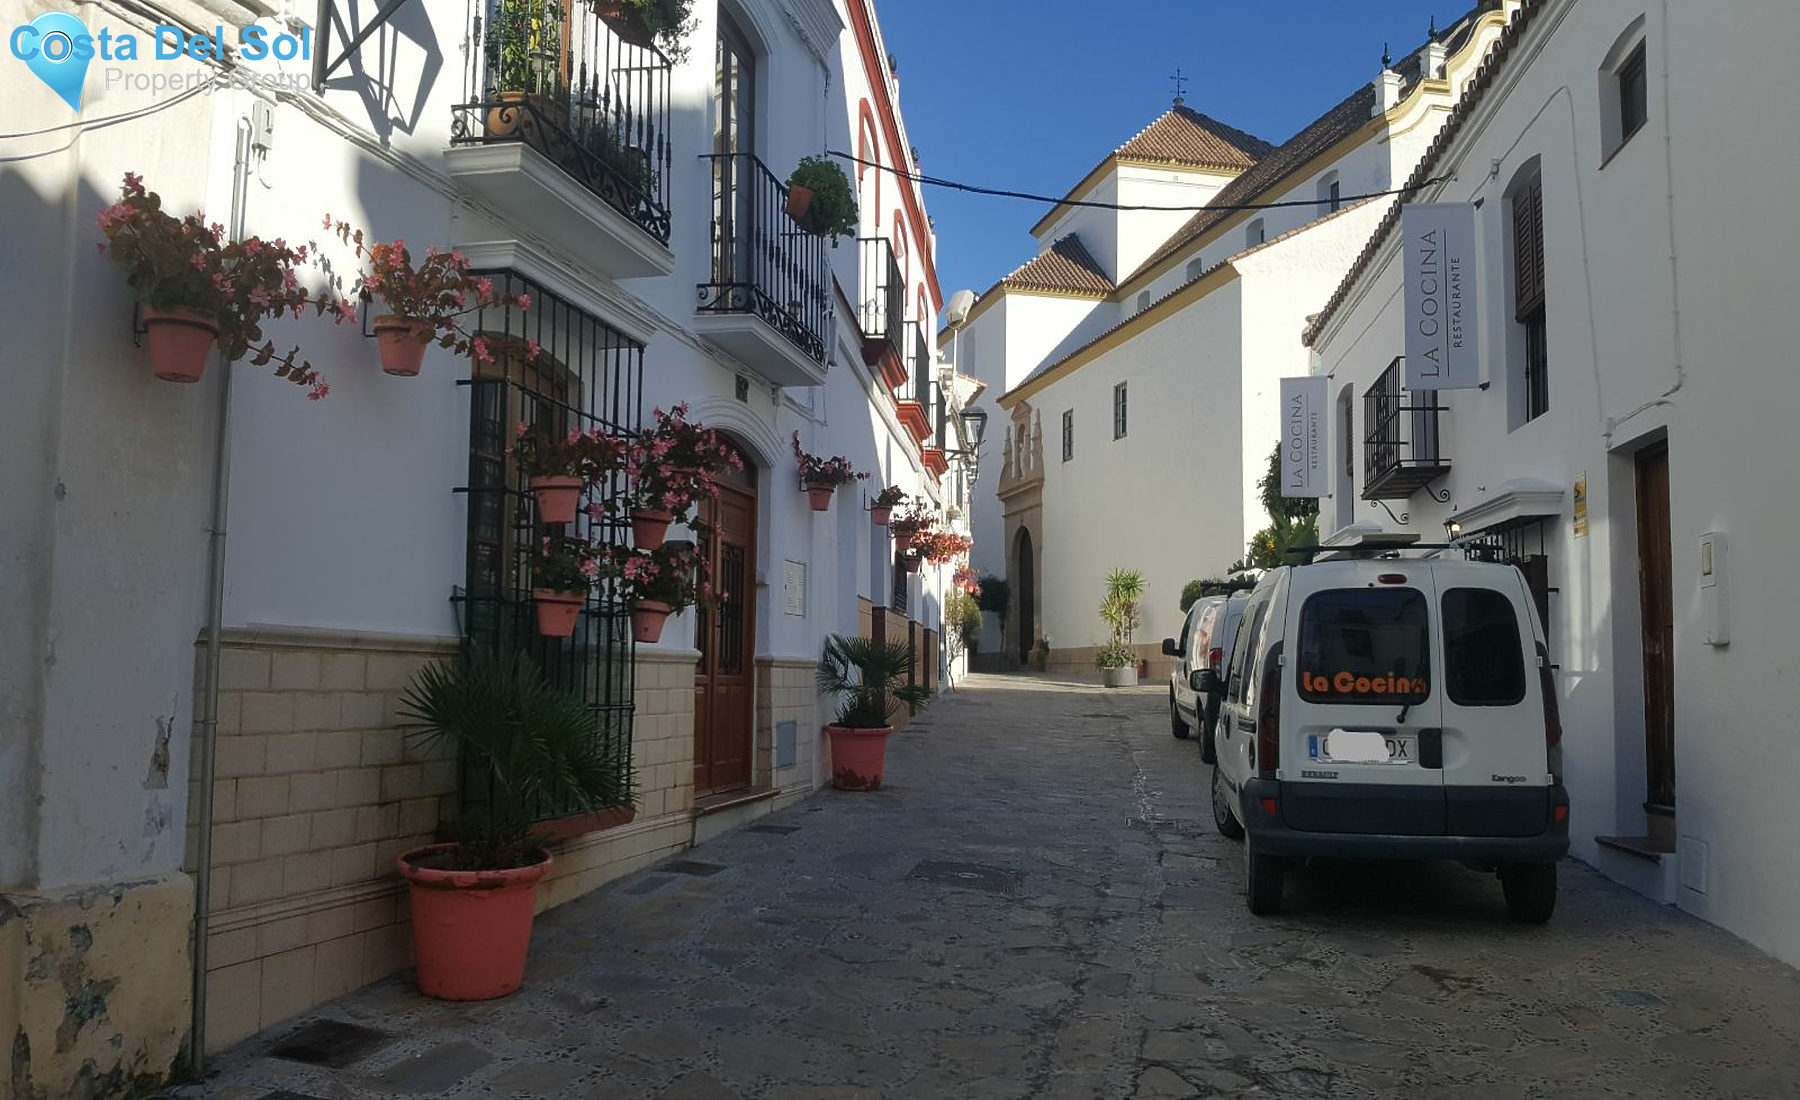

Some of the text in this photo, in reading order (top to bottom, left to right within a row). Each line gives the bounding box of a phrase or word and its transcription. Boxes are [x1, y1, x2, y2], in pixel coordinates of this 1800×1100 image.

[1419, 228, 1440, 379] LA COCINA
[1451, 257, 1462, 348] RESTAURANTE
[1290, 394, 1303, 488] LA COCINA
[1301, 770, 1339, 779] RENAULT
